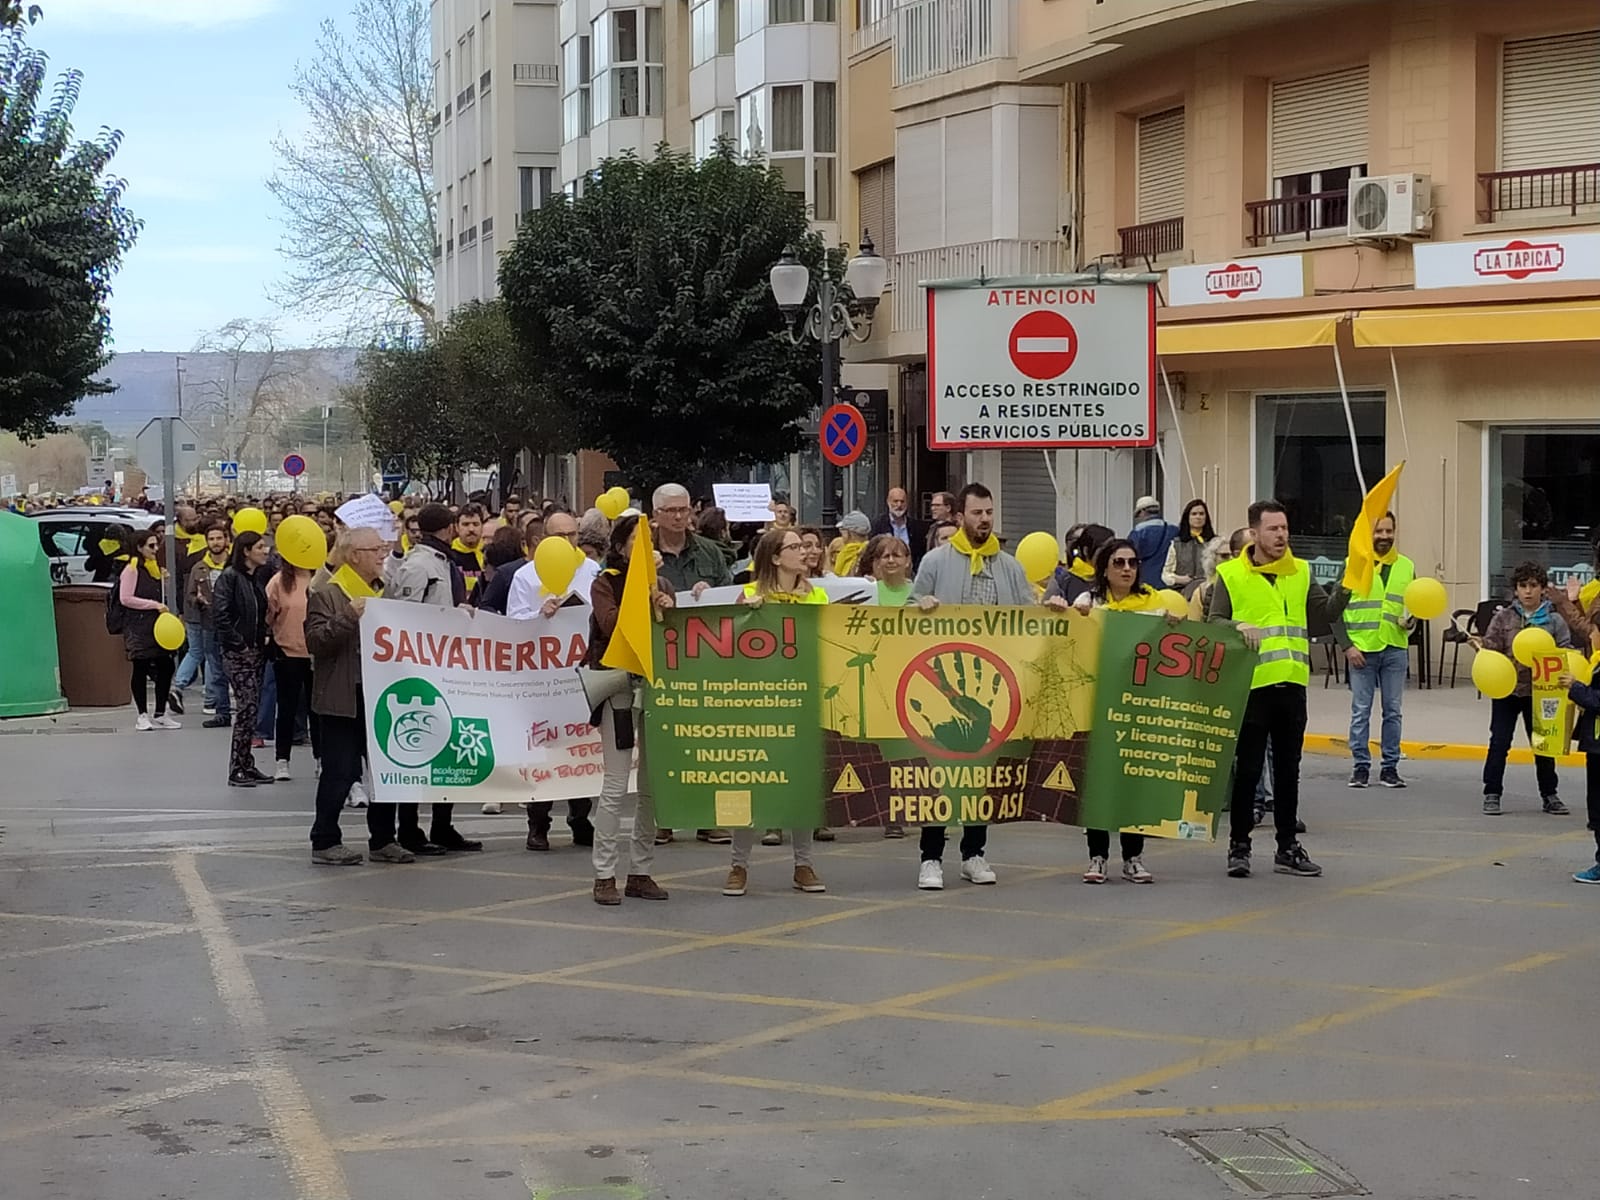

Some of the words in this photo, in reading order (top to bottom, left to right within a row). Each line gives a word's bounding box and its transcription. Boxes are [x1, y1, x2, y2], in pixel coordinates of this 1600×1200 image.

[1486, 254, 1501, 269] LA
[1506, 250, 1552, 268] TAPICA
[1213, 274, 1223, 290] LA
[1226, 271, 1254, 289] TAPICA
[987, 289, 1095, 305] ATENCION
[944, 384, 1016, 398] ACCESO
[1023, 382, 1140, 397] RESTRINGIDO
[979, 404, 990, 418] A
[998, 403, 1105, 418] RESIDENTES
[941, 426, 951, 439] Y
[960, 425, 1051, 439] SERVICIOS
[1058, 421, 1145, 438] PÚBLICOS
[845, 609, 1070, 637] #salvemosVillena
[372, 626, 588, 672] SALVATIERRA
[664, 616, 798, 669] ¡No!
[1133, 633, 1226, 686] ¡Sí!
[653, 679, 666, 690] A
[671, 681, 697, 691] una
[703, 679, 807, 694] Implantación
[656, 695, 674, 707] de
[678, 695, 698, 707] las
[704, 696, 803, 708] Renovables:
[1107, 708, 1131, 722] las
[1212, 705, 1232, 719] de
[674, 724, 796, 738] INSOSTENIBLE
[1116, 730, 1126, 742] y
[1131, 728, 1196, 748] licencias
[1206, 738, 1223, 752] las
[696, 749, 769, 762] INJUSTA
[380, 773, 428, 785] Villena
[432, 776, 443, 784] en
[445, 774, 471, 784] acción
[681, 771, 789, 784] IRRACIONAL
[890, 766, 1011, 789] RENOVABLES
[890, 796, 953, 822] PERO
[961, 796, 994, 822] NO
